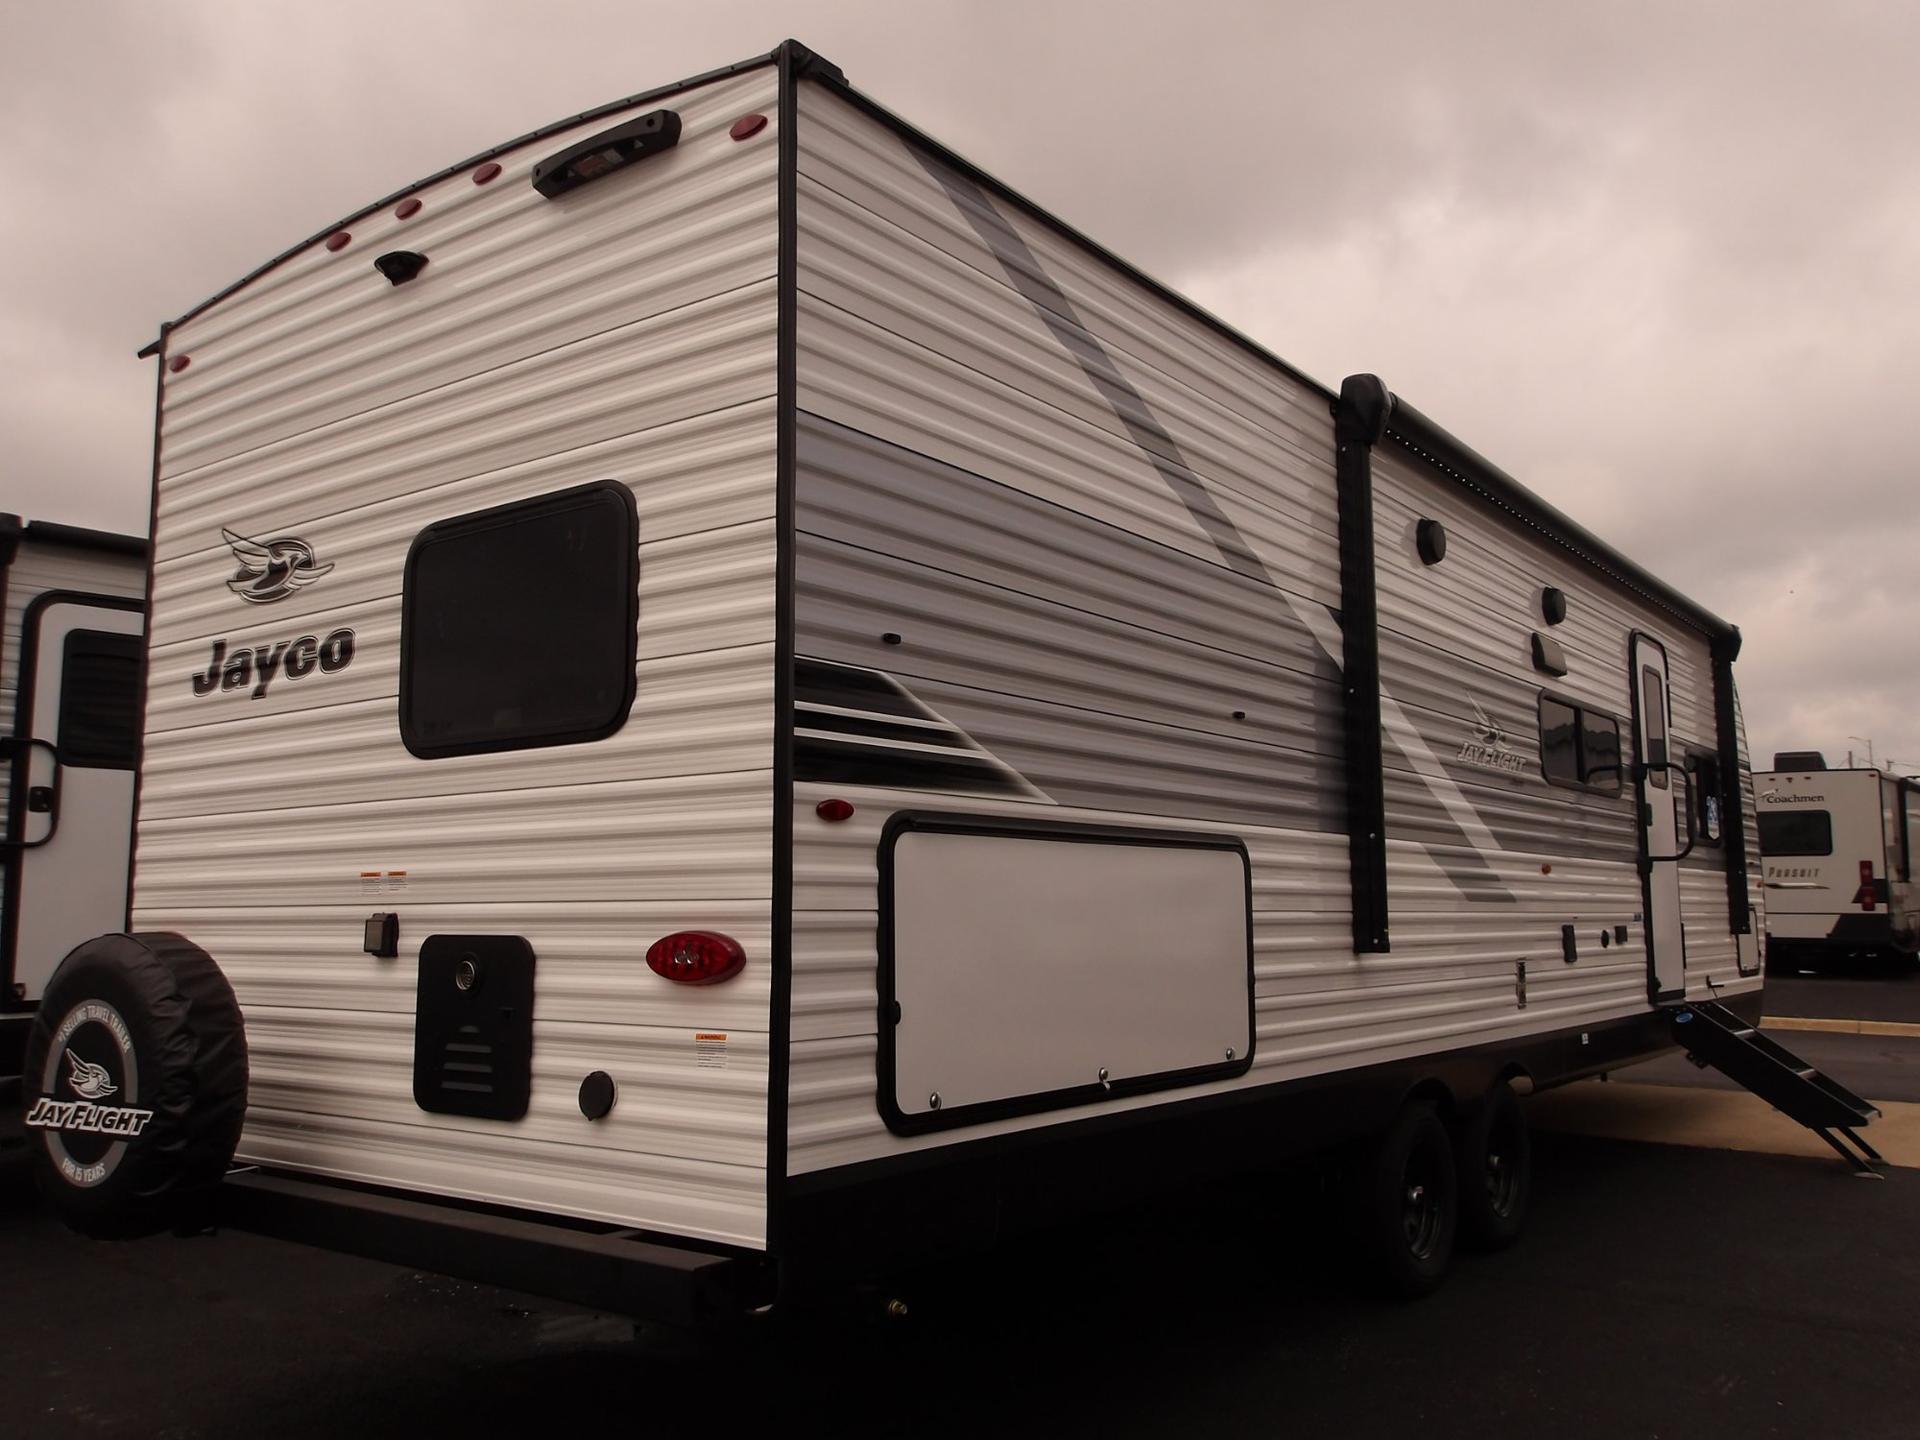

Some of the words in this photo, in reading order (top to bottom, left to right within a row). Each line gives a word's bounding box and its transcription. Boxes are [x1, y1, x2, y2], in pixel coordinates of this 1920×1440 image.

[192, 627, 356, 700] Jayco
[1766, 794, 1824, 804] Coachmen
[87, 1005, 110, 1024] TRAVEL
[109, 1014, 132, 1054] TRAILER
